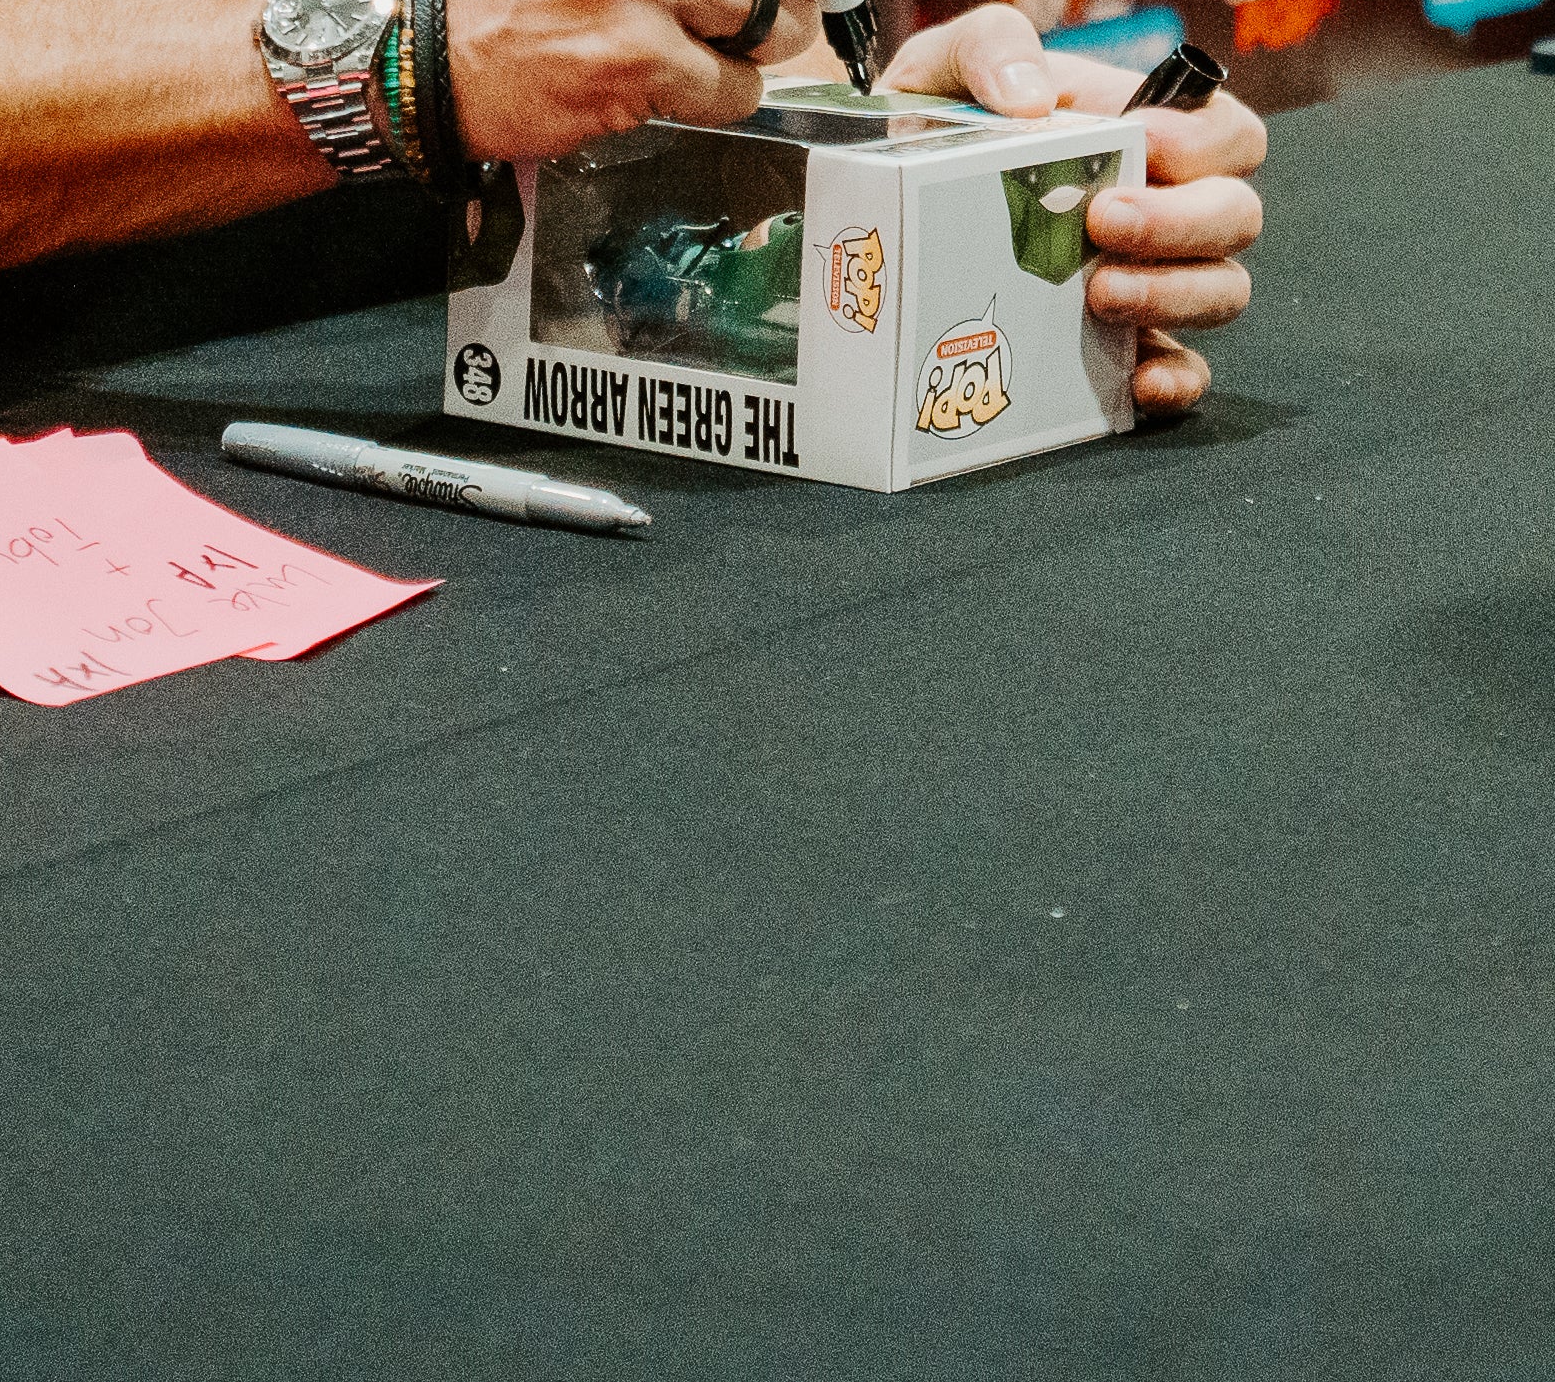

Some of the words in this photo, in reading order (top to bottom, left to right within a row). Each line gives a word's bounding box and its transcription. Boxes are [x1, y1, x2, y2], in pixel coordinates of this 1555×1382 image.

[831, 247, 842, 307] TELEVISION
[841, 227, 885, 335] POP!
[461, 347, 493, 405] 348
[940, 333, 994, 358] TELEVISION
[523, 356, 630, 439] ARROW
[637, 375, 734, 459] GREEN
[914, 345, 1012, 435] POP!
[743, 393, 800, 469] THE
[401, 472, 483, 510] Sharpie
